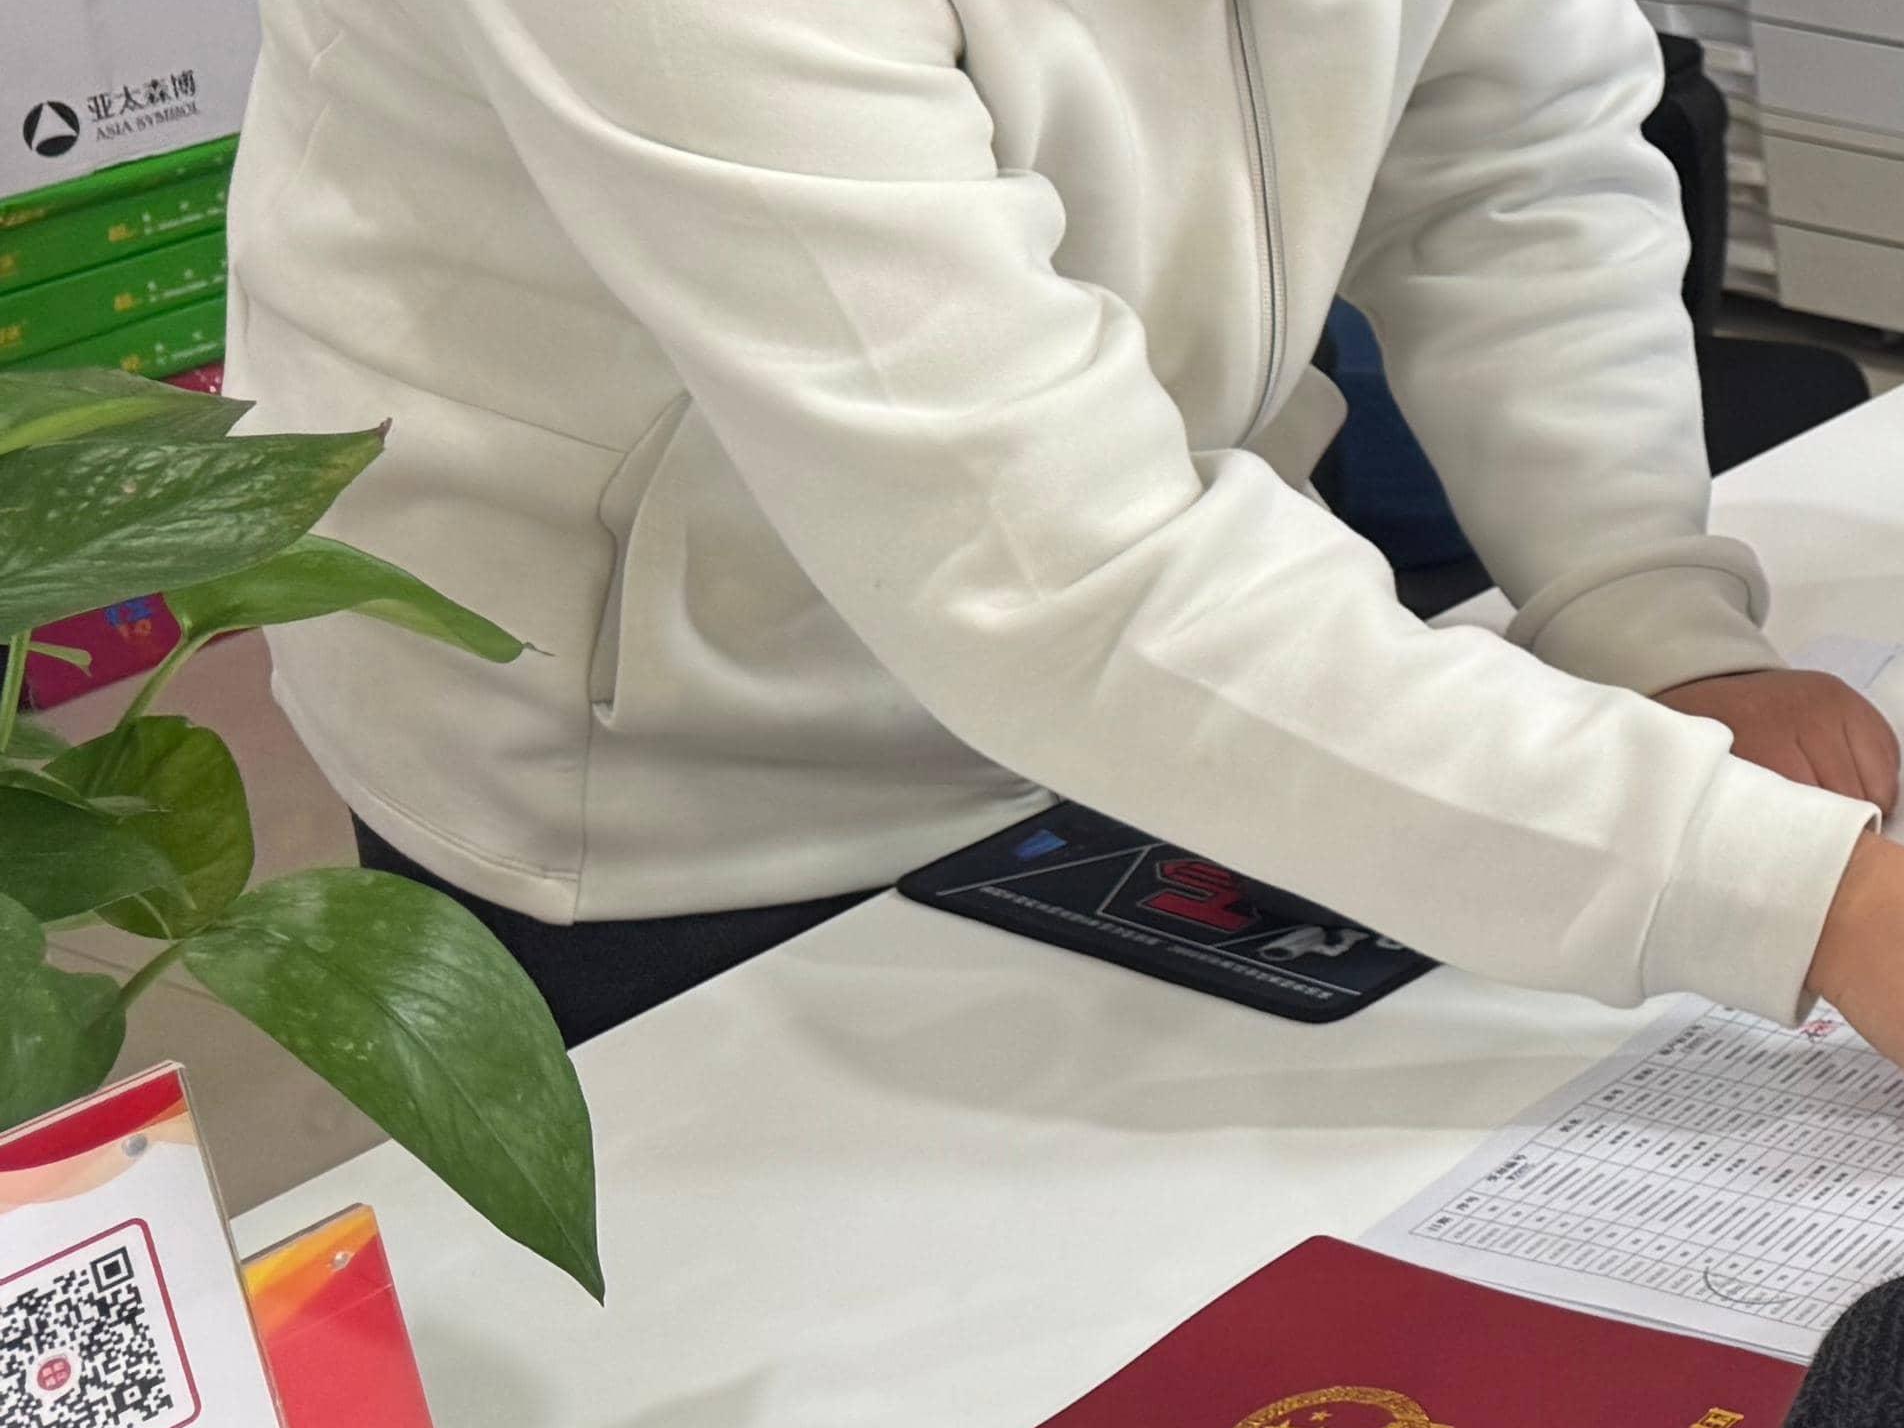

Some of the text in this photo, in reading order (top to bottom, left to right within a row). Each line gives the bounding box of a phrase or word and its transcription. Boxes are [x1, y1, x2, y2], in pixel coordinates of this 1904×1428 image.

[87, 69, 197, 123] 亚太森博
[96, 121, 133, 141] ASIA
